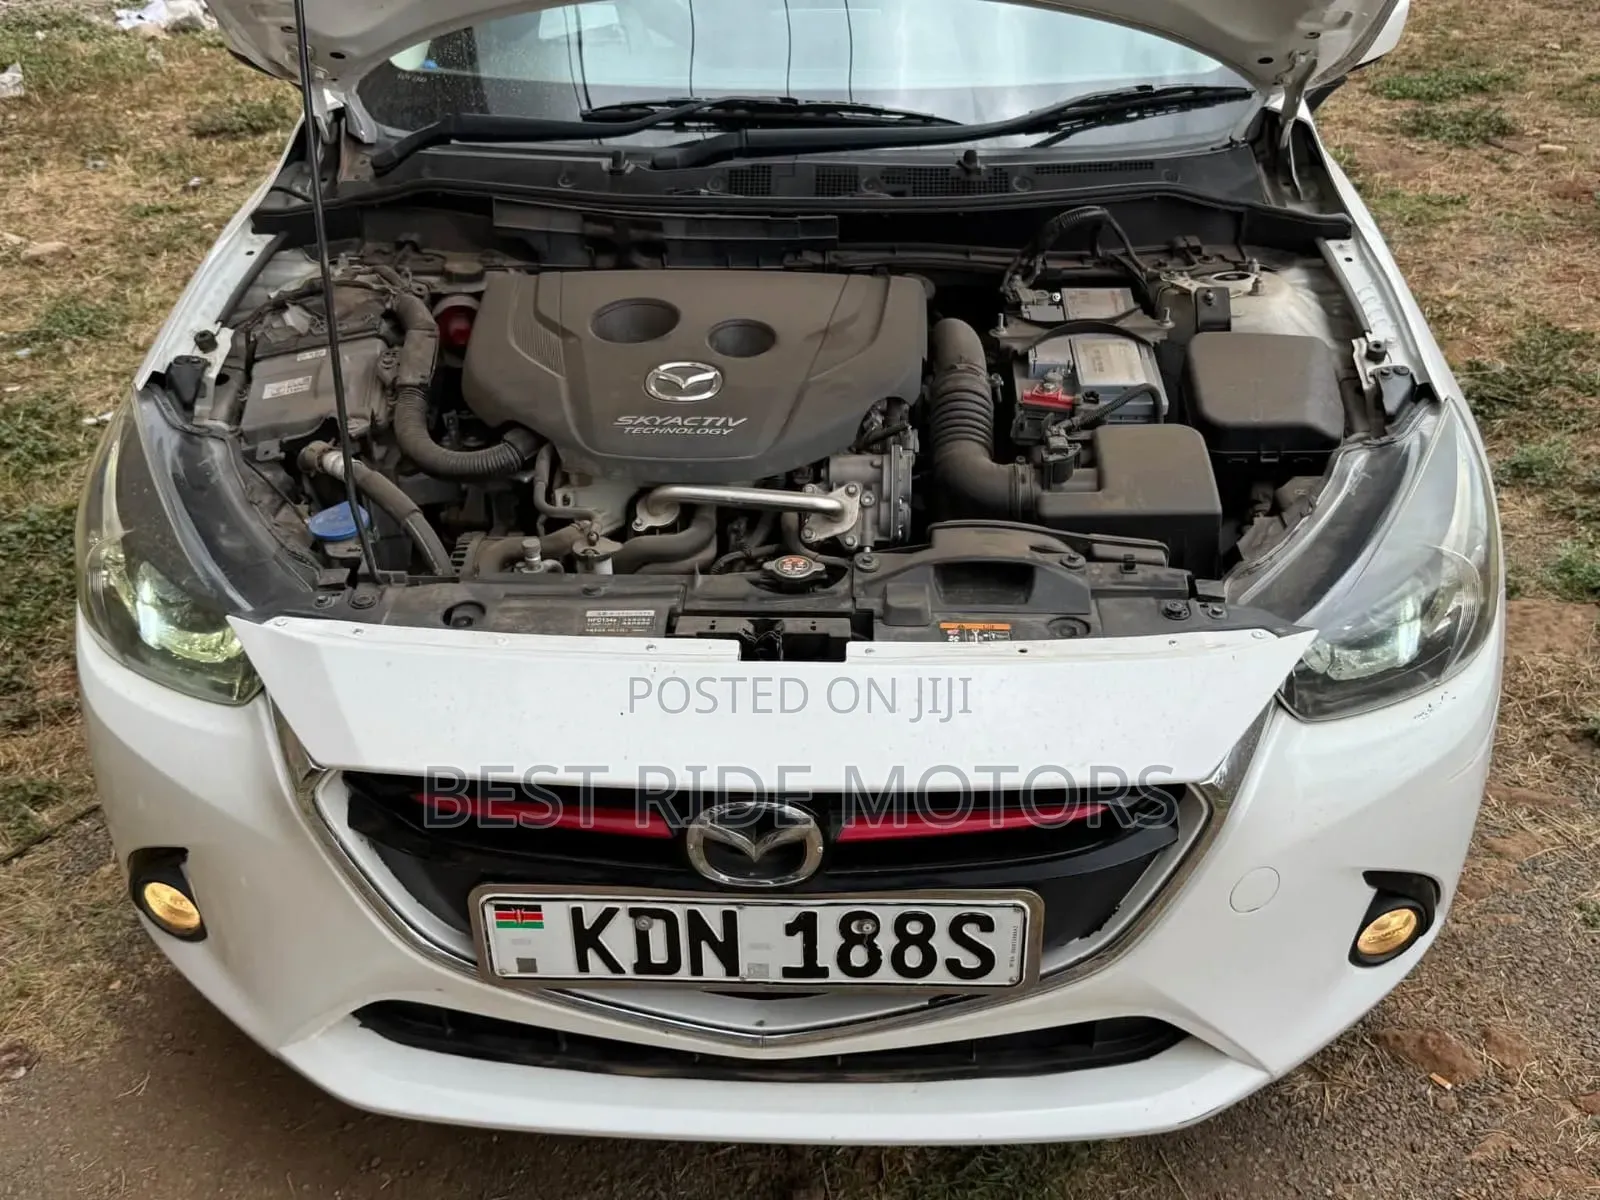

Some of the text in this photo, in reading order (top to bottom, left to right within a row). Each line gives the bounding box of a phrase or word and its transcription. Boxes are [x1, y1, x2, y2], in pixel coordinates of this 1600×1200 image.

[613, 415, 748, 427] SKYACTIV
[623, 426, 733, 435] TECHNOLOGY
[570, 906, 740, 977] KDN
[781, 910, 996, 980] 188S
